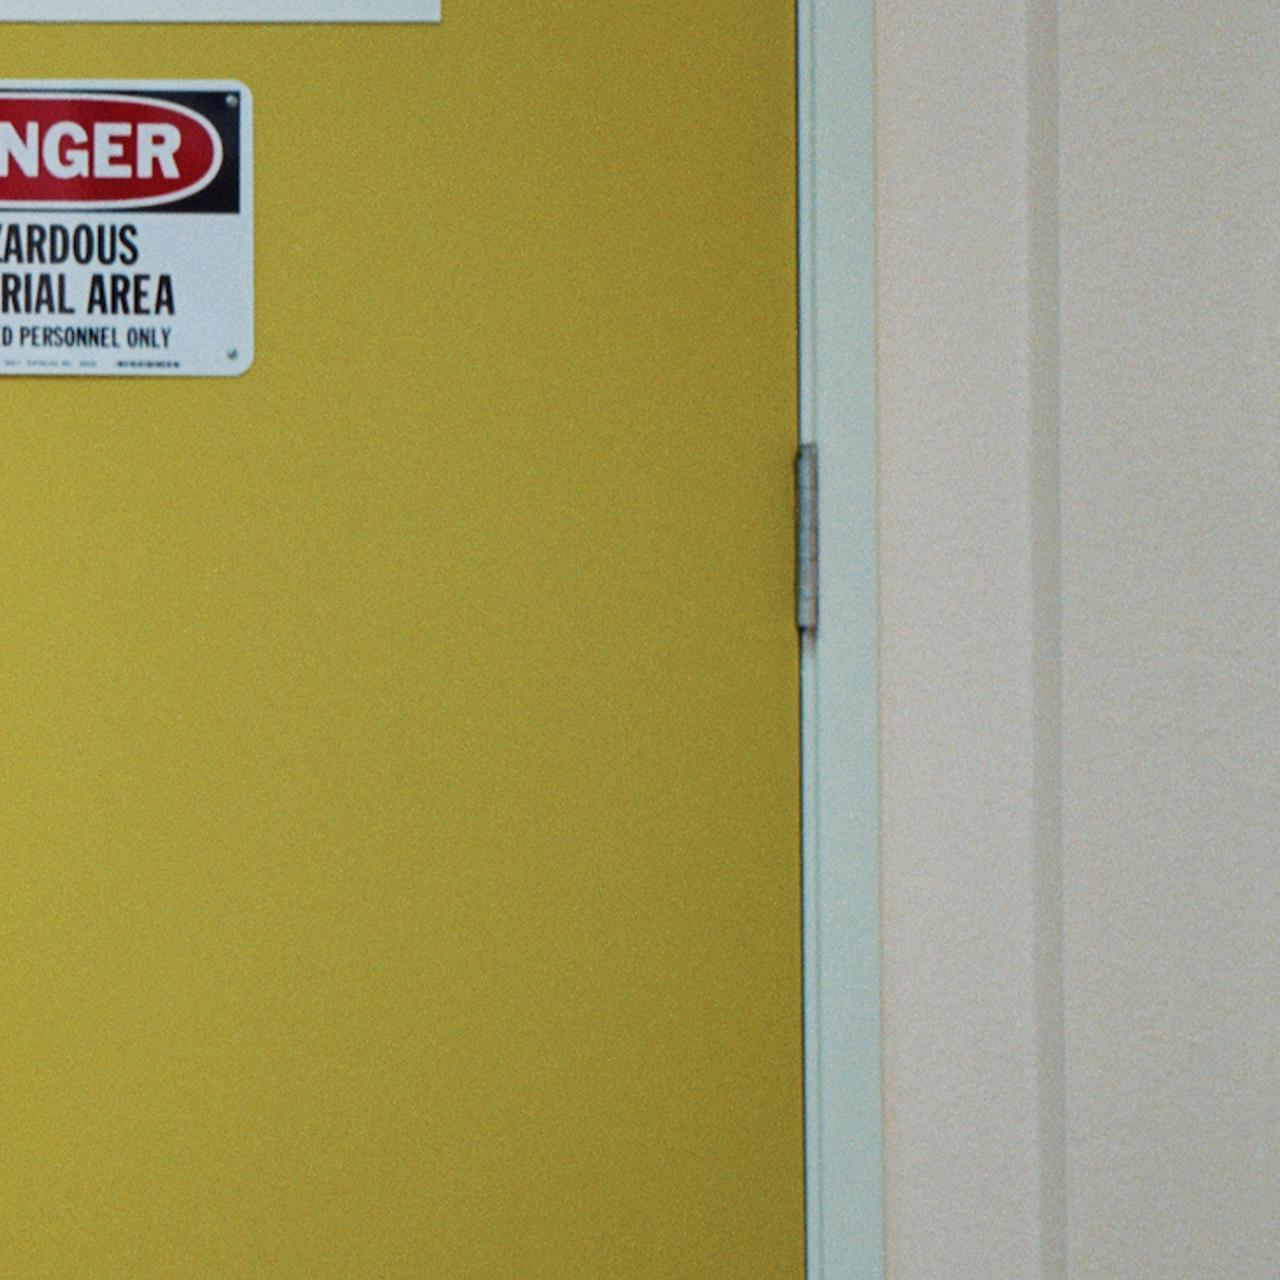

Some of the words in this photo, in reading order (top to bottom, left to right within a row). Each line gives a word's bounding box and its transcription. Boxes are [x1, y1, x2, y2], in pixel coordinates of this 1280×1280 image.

[86, 274, 176, 316] AREA
[19, 326, 120, 348] PERSONNEL
[127, 326, 173, 349] ONLY
